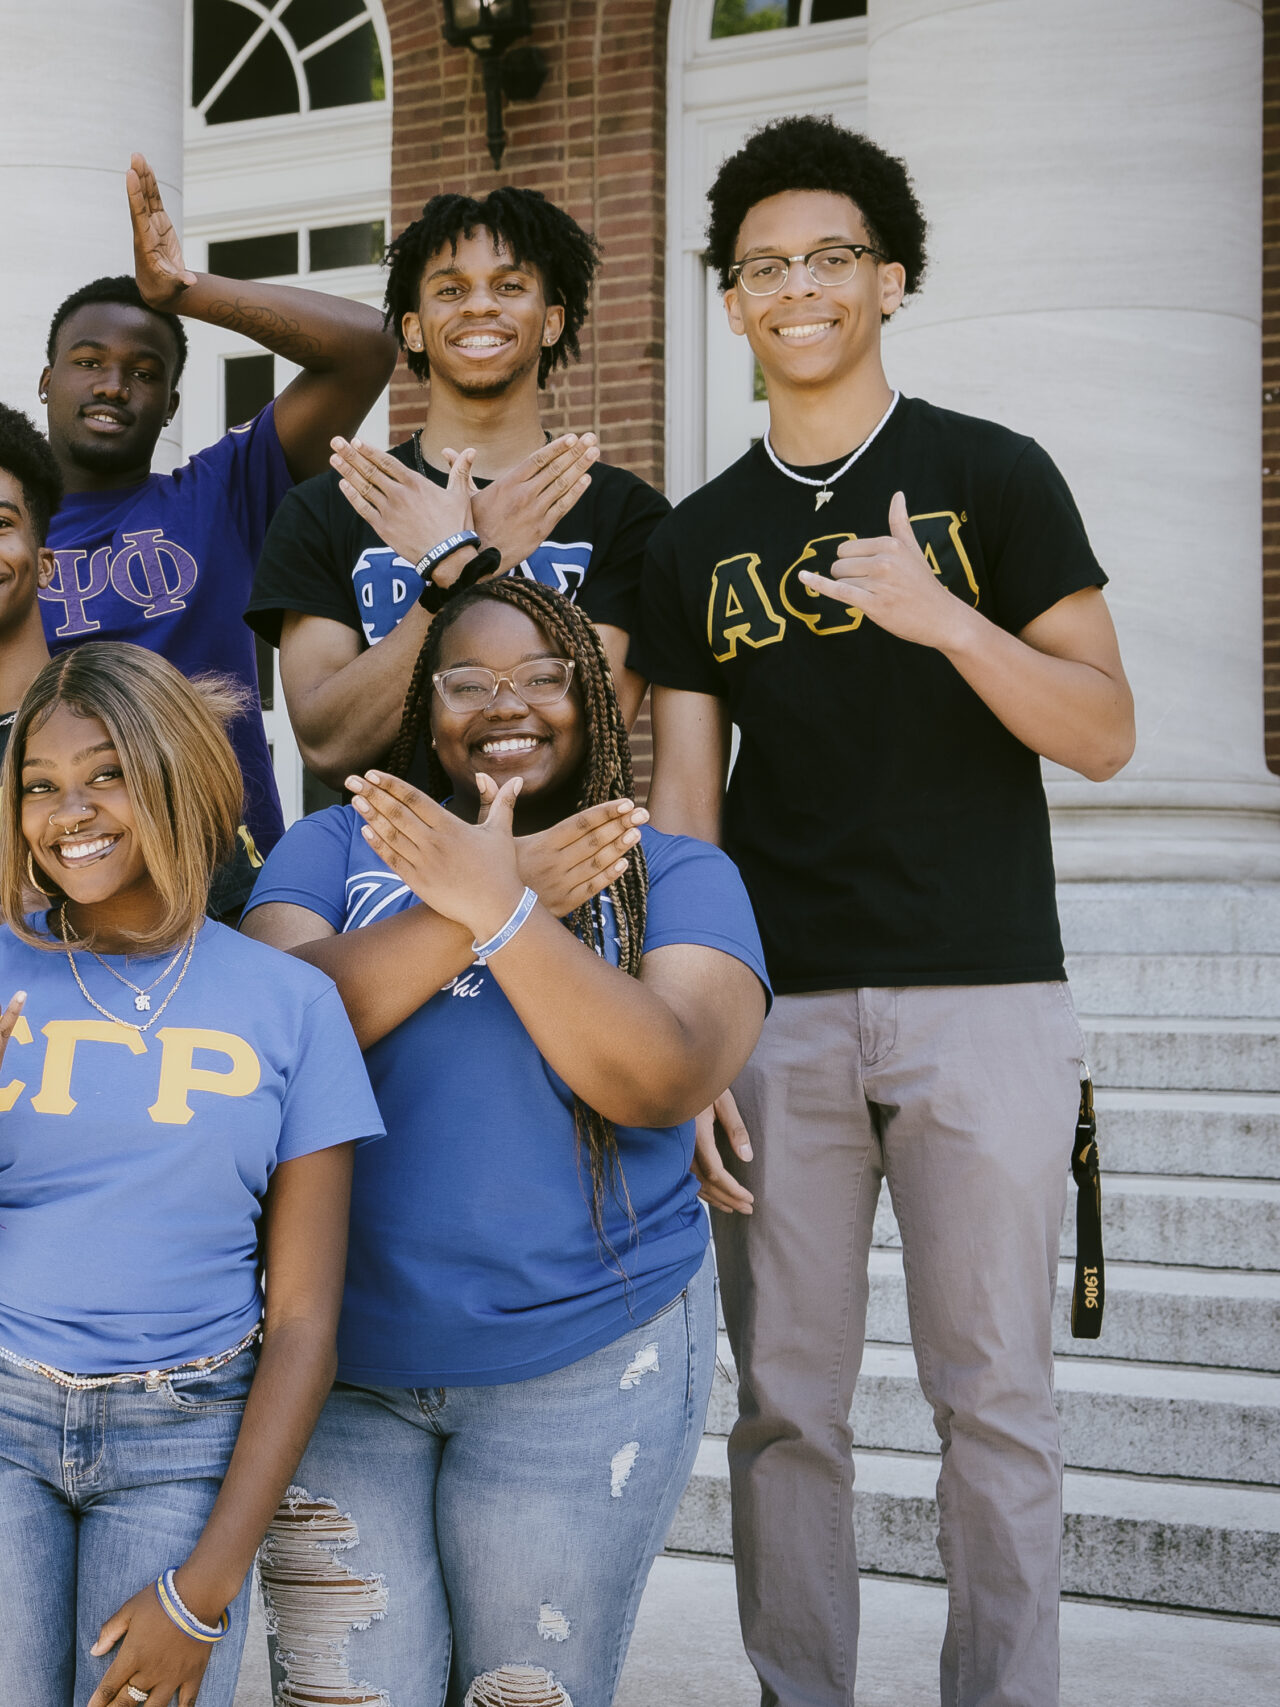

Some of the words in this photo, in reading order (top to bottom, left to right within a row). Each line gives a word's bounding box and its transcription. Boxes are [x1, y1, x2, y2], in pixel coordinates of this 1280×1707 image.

[448, 534, 464, 546] PHI
[429, 542, 449, 560] BETA
[1083, 1265, 1099, 1309] 1906
